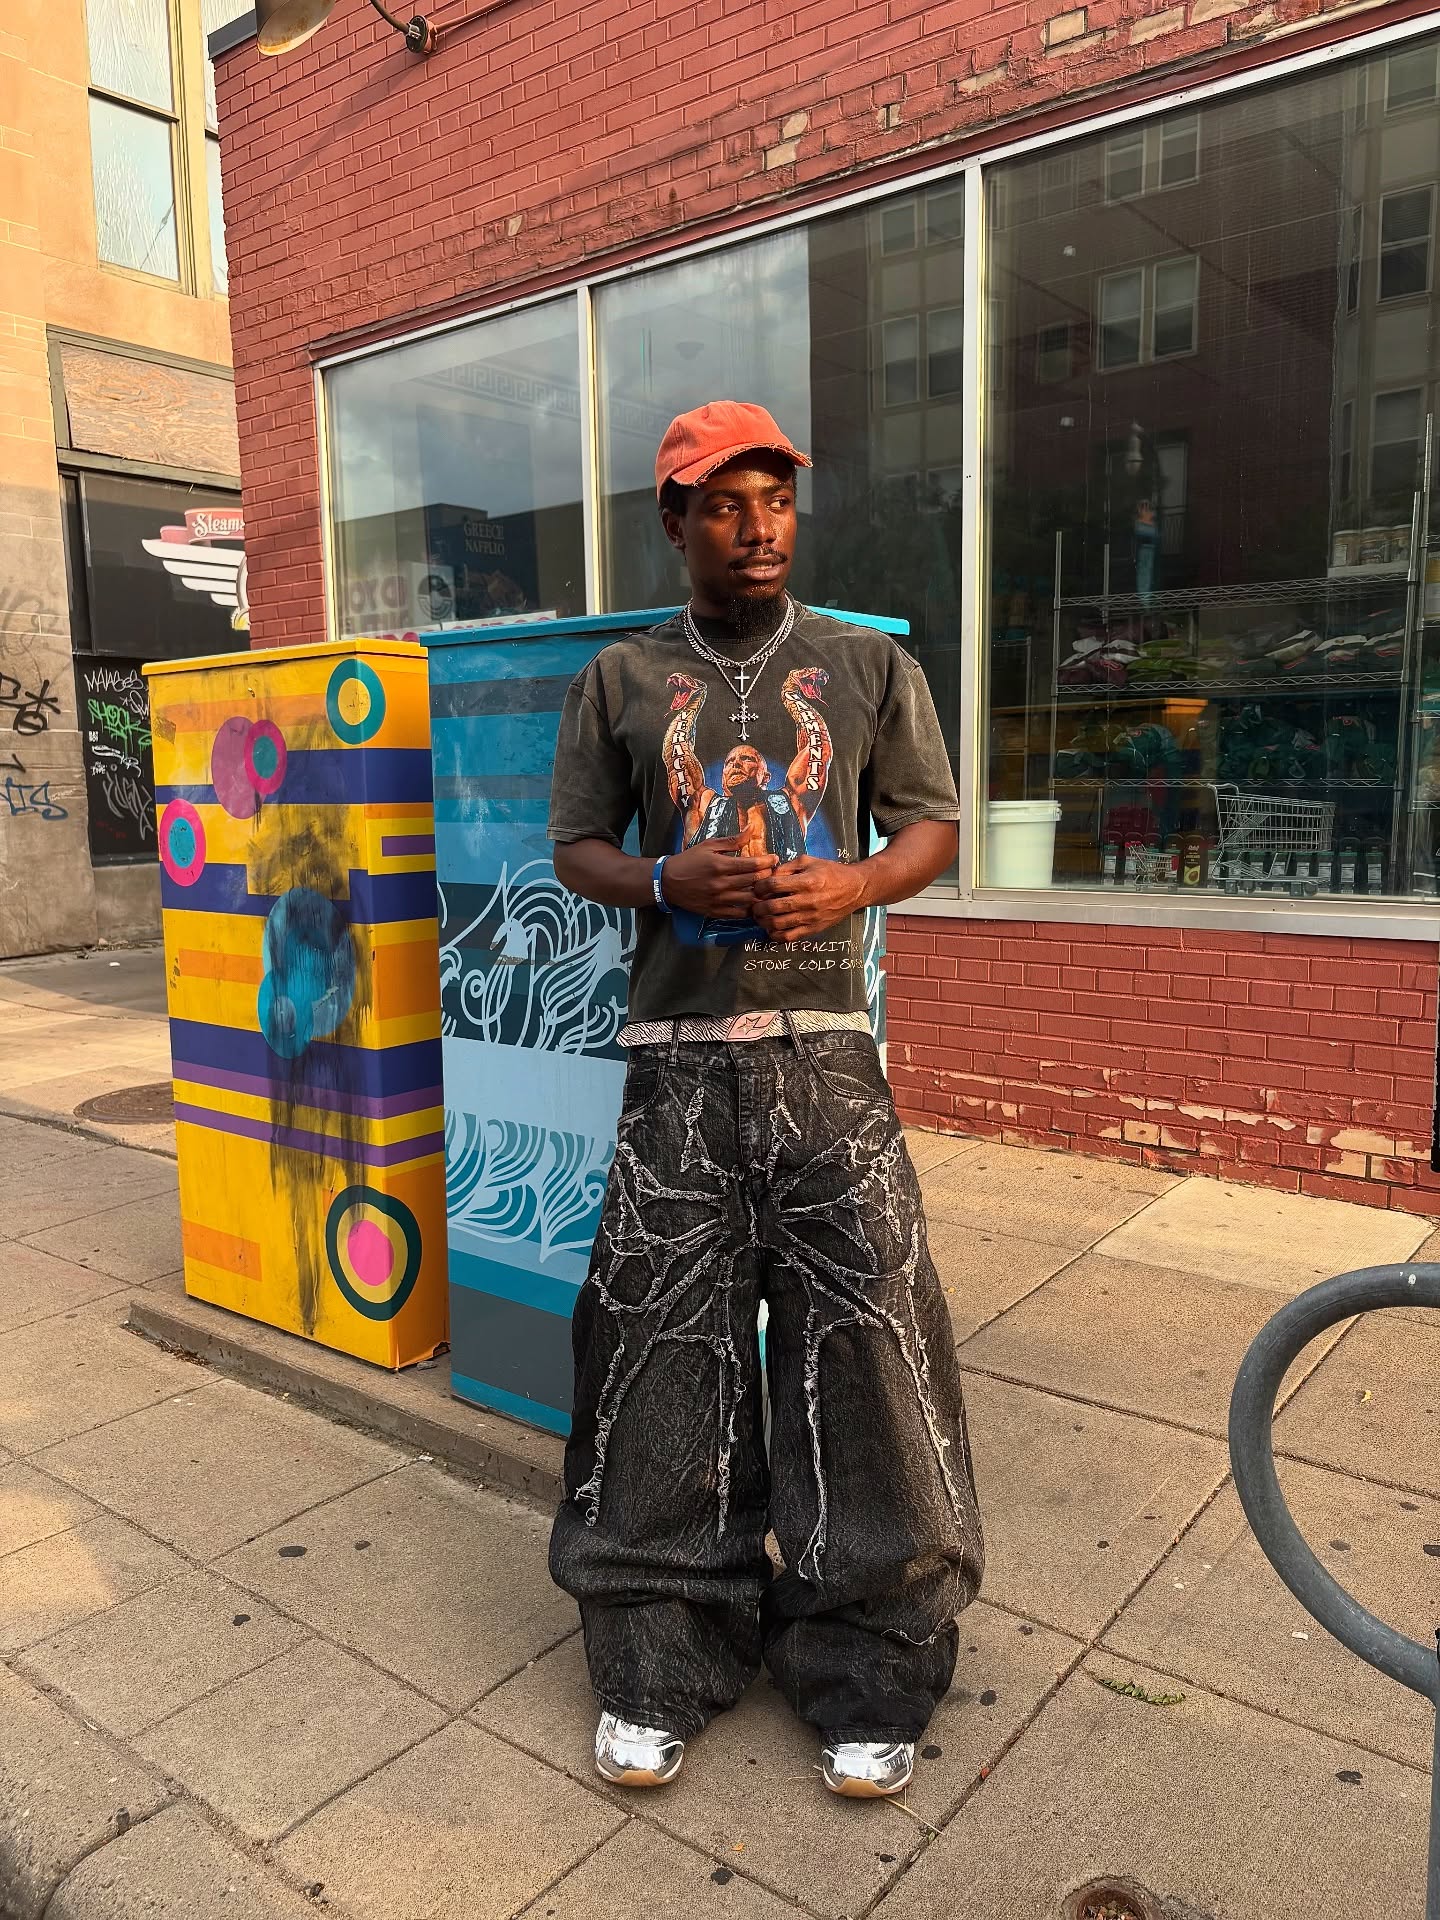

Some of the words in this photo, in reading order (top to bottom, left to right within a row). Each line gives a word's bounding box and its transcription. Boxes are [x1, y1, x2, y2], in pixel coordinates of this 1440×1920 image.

[671, 710, 694, 807] VERACITY
[785, 691, 823, 791] GARMENTS
[743, 959, 792, 971] STONE
[798, 960, 836, 971] COLD
